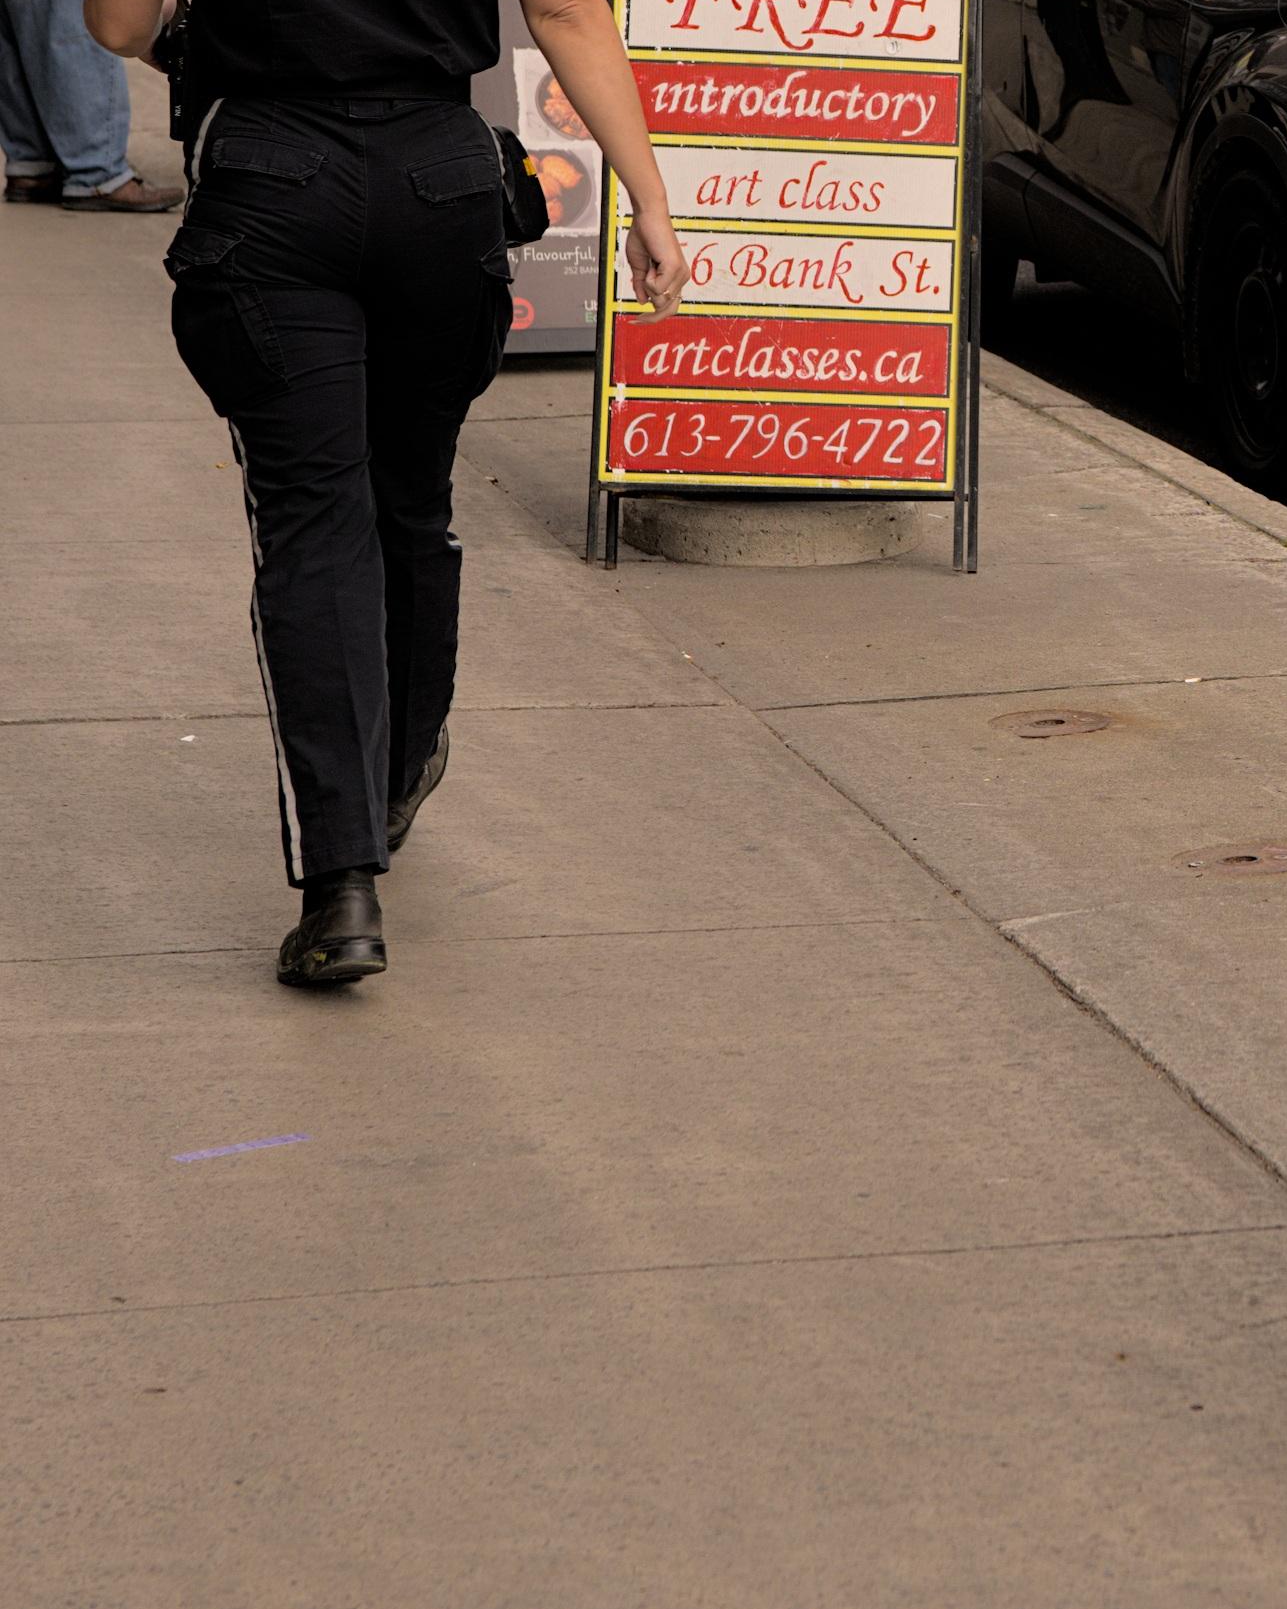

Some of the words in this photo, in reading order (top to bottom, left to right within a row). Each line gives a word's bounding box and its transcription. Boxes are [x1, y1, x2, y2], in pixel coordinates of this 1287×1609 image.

[651, 72, 937, 137] introductory
[696, 169, 763, 207] art
[778, 160, 886, 213] class
[523, 246, 596, 266] Flavourful,
[729, 241, 865, 305] Bank
[879, 249, 941, 297] St.
[642, 327, 924, 385] artclasses.ca
[623, 412, 942, 466] 613-796-4722
